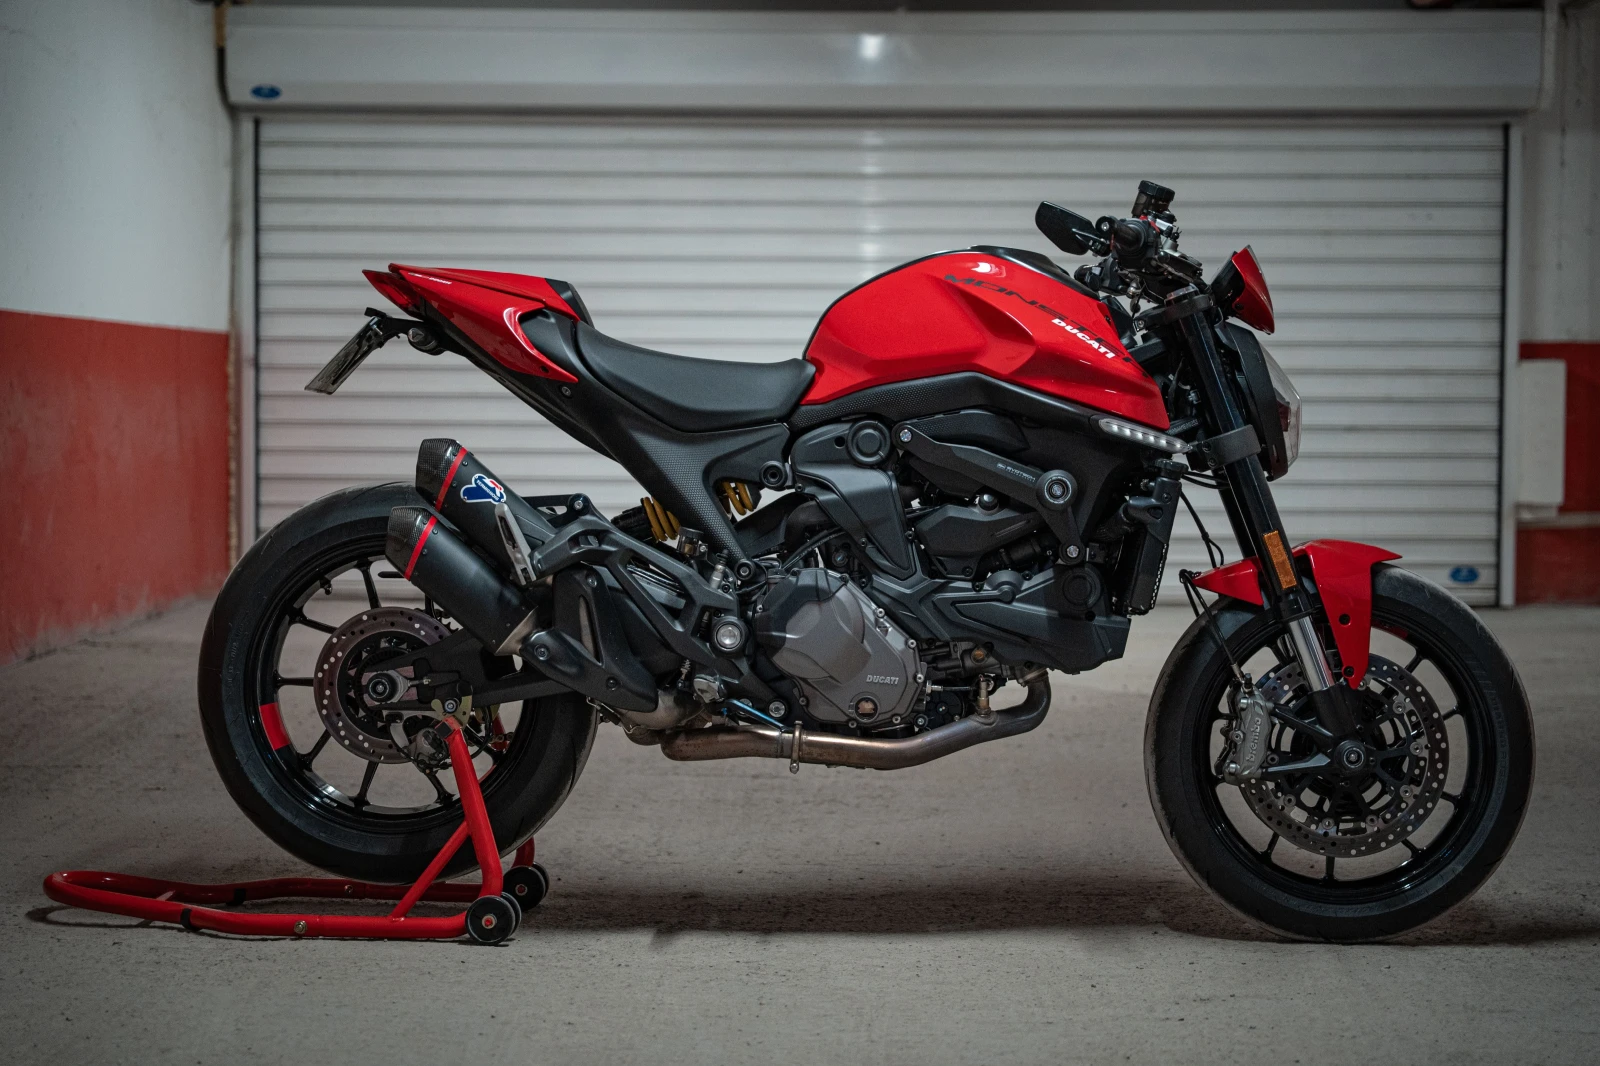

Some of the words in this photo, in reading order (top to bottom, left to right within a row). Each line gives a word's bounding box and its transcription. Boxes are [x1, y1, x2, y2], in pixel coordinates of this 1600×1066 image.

[1051, 318, 1116, 359] DUCATI
[866, 674, 899, 685] DUCATI
[1246, 717, 1261, 762] brembo
